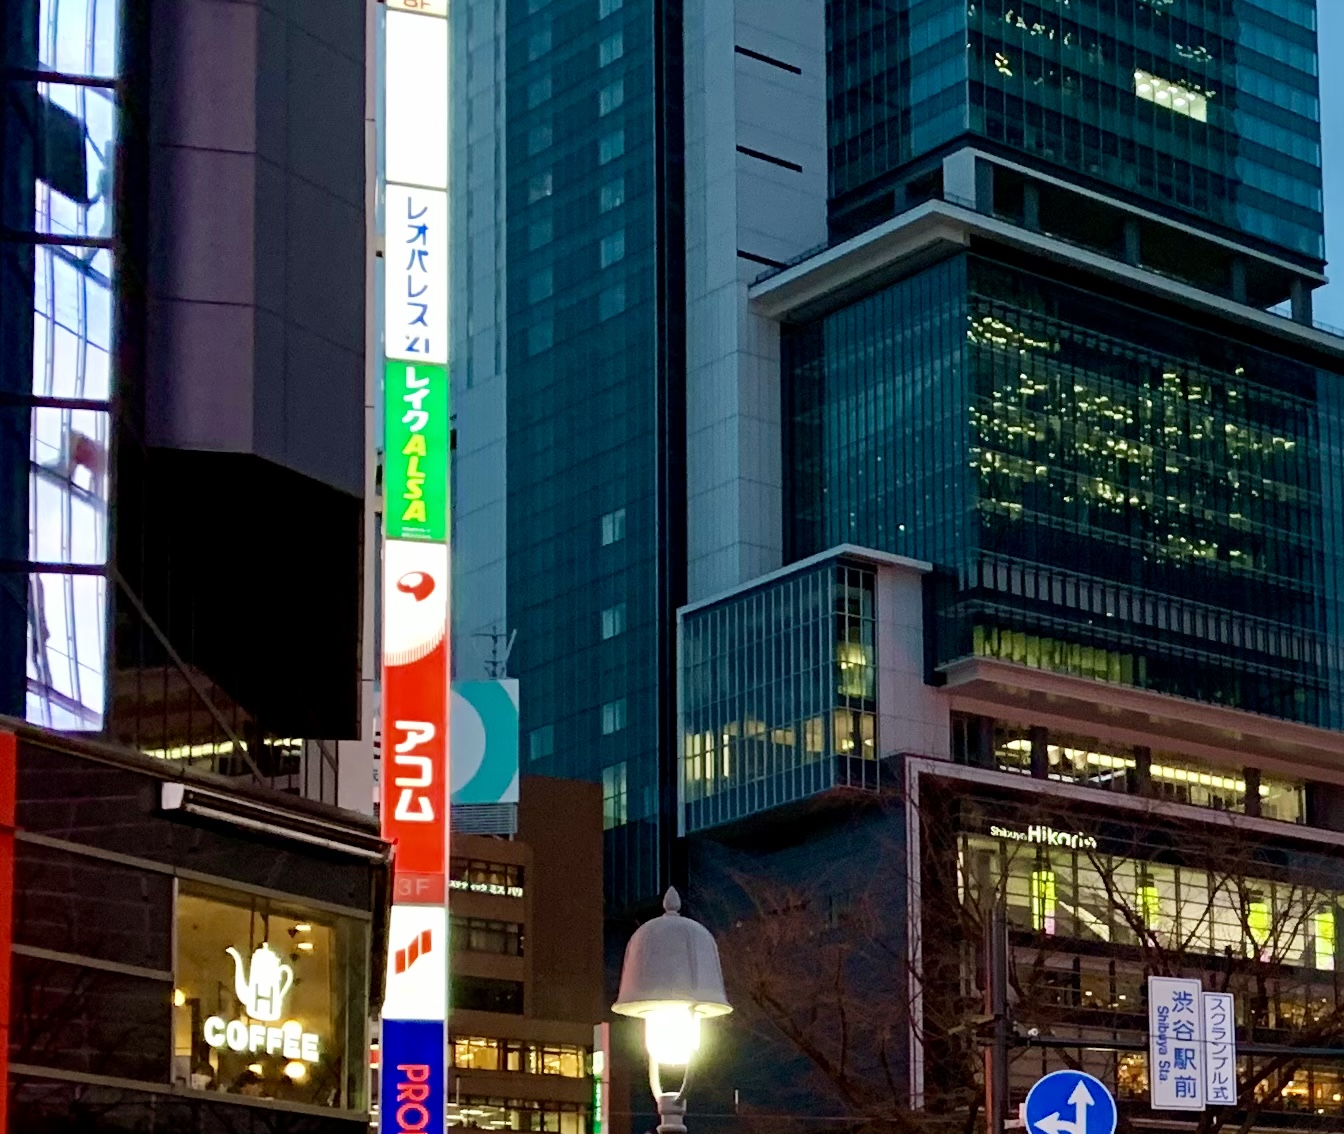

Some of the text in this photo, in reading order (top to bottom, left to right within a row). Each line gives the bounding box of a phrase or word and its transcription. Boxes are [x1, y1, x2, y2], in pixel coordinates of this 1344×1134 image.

[405, 196, 430, 354] レオパレス21
[401, 366, 431, 522] レイクALSA
[394, 720, 435, 822] アコム
[399, 879, 431, 896] 3F
[203, 1015, 320, 1063] COFFEE
[1156, 1005, 1170, 1055] Shibuya
[1171, 990, 1197, 1099] 渋谷駅前
[1210, 998, 1229, 1100] スクランブル式
